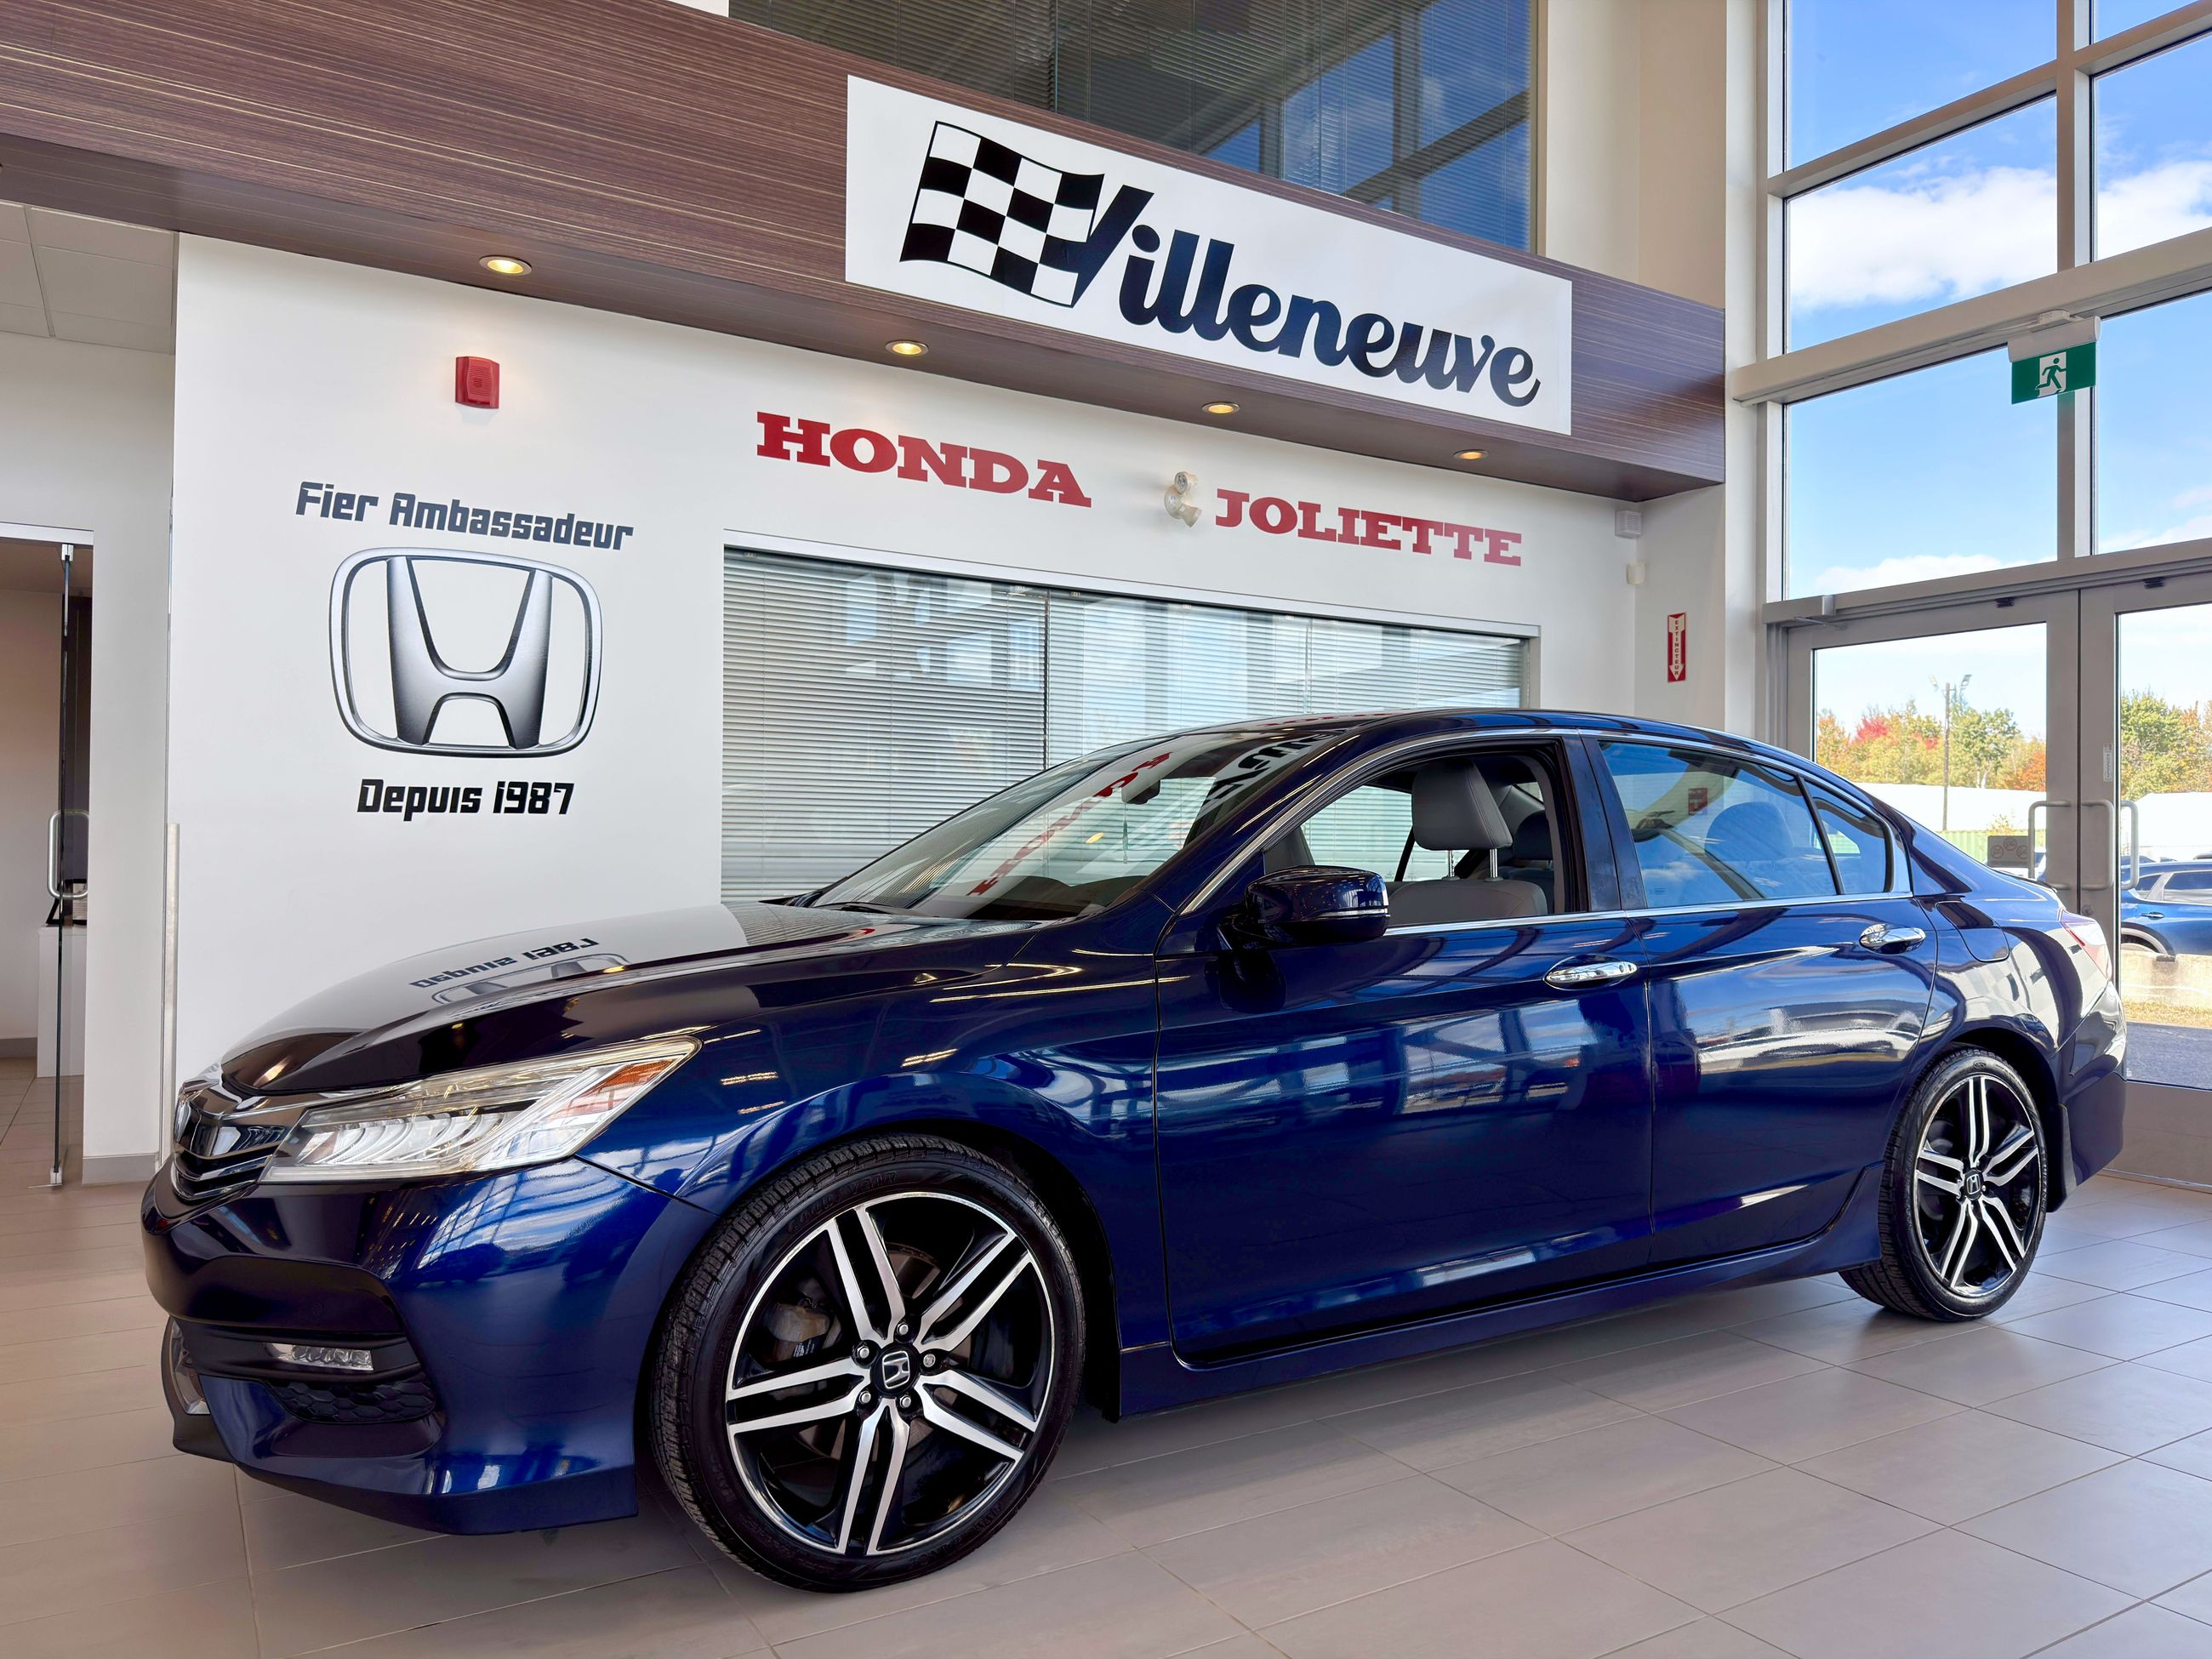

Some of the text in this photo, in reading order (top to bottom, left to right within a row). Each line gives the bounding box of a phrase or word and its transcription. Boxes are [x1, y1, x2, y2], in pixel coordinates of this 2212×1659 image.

[1059, 174, 1542, 408] Villeneuve
[295, 481, 635, 551] Fier Ambassadeur
[756, 411, 1522, 567] HONDA JOLIETTE
[356, 778, 576, 822] Depuis 1987
